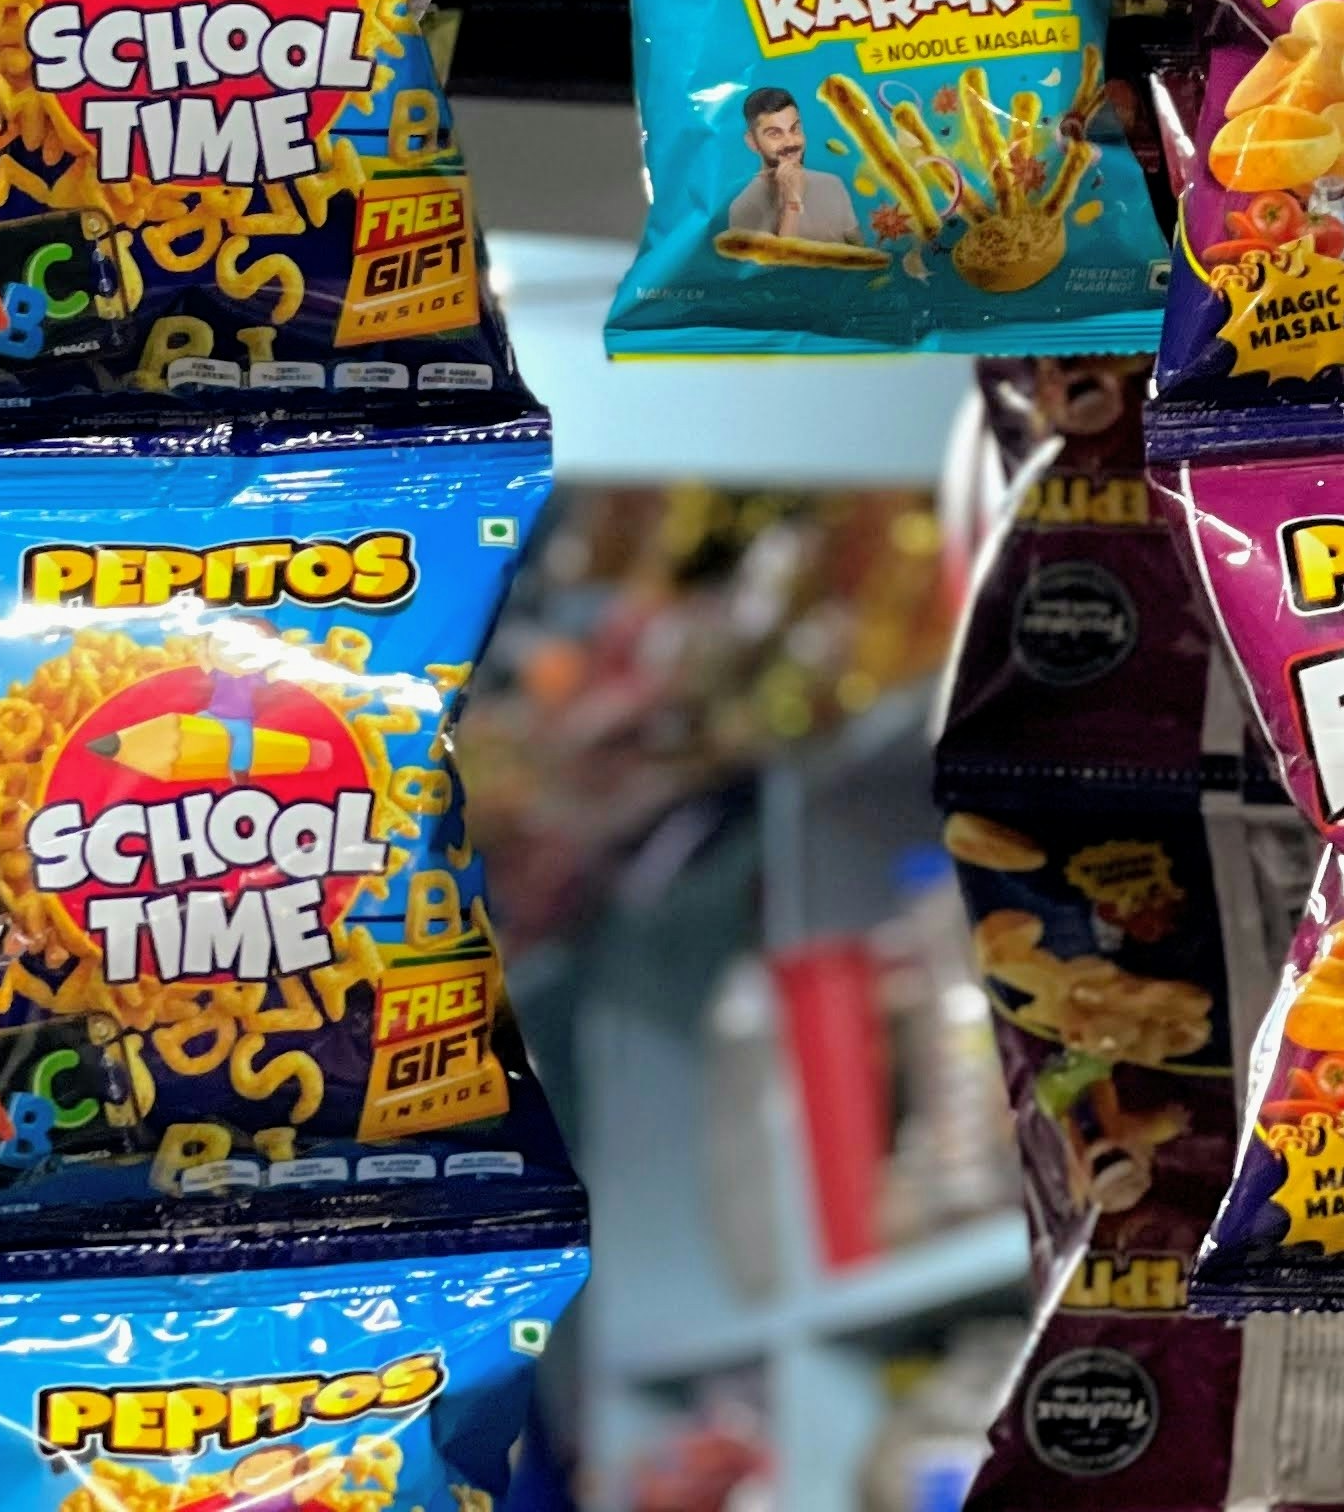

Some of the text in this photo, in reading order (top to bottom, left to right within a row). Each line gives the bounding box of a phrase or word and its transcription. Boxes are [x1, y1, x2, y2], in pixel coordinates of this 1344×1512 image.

[25, 0, 380, 93] SCHOOL
[886, 27, 1059, 64] NOODLE MASALA
[82, 92, 319, 186] TIME
[360, 188, 462, 249] FREE
[363, 235, 467, 297] GIFT
[358, 293, 466, 327] INSIDE
[1255, 285, 1343, 323] MAGIC
[26, 535, 413, 608] PEPITOS
[27, 788, 393, 892] SCHOOL
[85, 878, 334, 984] TIME
[379, 977, 485, 1040] FREE
[386, 1030, 492, 1089] GIFT
[379, 1079, 495, 1122] INSIDE
[40, 1354, 446, 1456] PEPITOS
